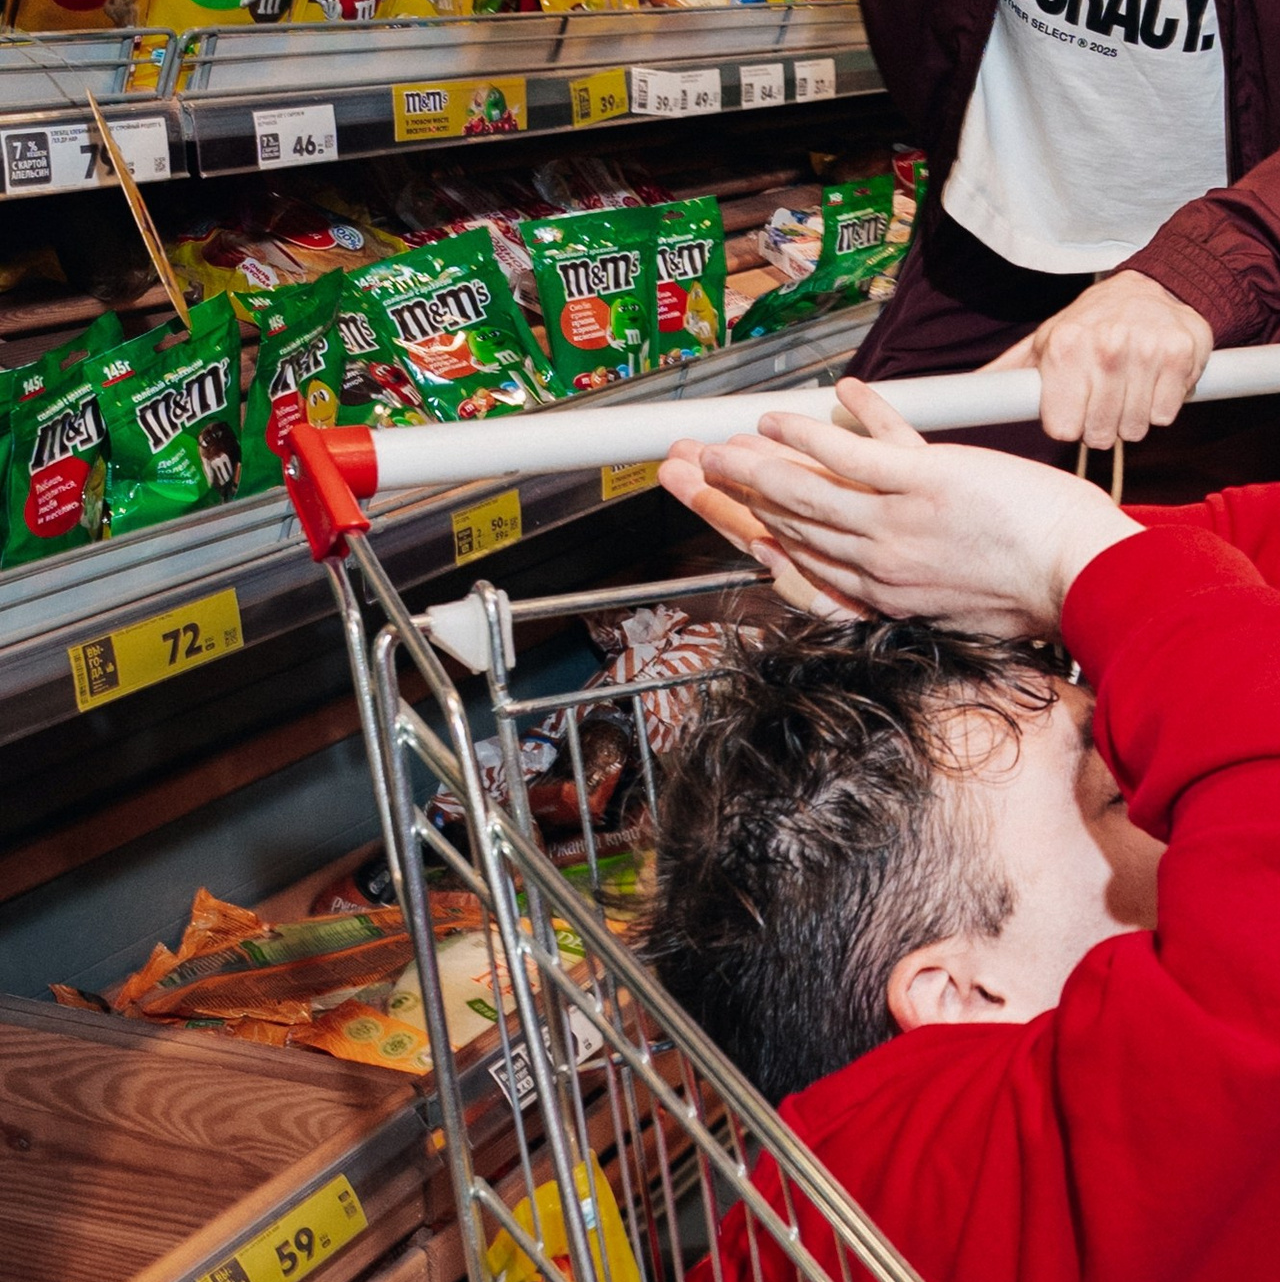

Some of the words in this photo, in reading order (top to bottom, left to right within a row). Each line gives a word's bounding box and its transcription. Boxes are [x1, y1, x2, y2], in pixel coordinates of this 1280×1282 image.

[1031, 18, 1076, 43] SELECT
[1089, 42, 1118, 58] 2025
[600, 94, 616, 113] 39
[13, 142, 22, 159] 7
[28, 141, 37, 152] %
[293, 135, 316, 156] 46
[18, 159, 47, 169] КАРТОЙ
[11, 169, 49, 180] АПЕЛЬСИН
[557, 251, 640, 301] m&m's
[387, 279, 491, 344] m&m's
[103, 360, 130, 380] 145г
[22, 375, 44, 395] 145г
[491, 516, 504, 532] 50
[162, 622, 203, 665] 72
[275, 1227, 314, 1277] 59
